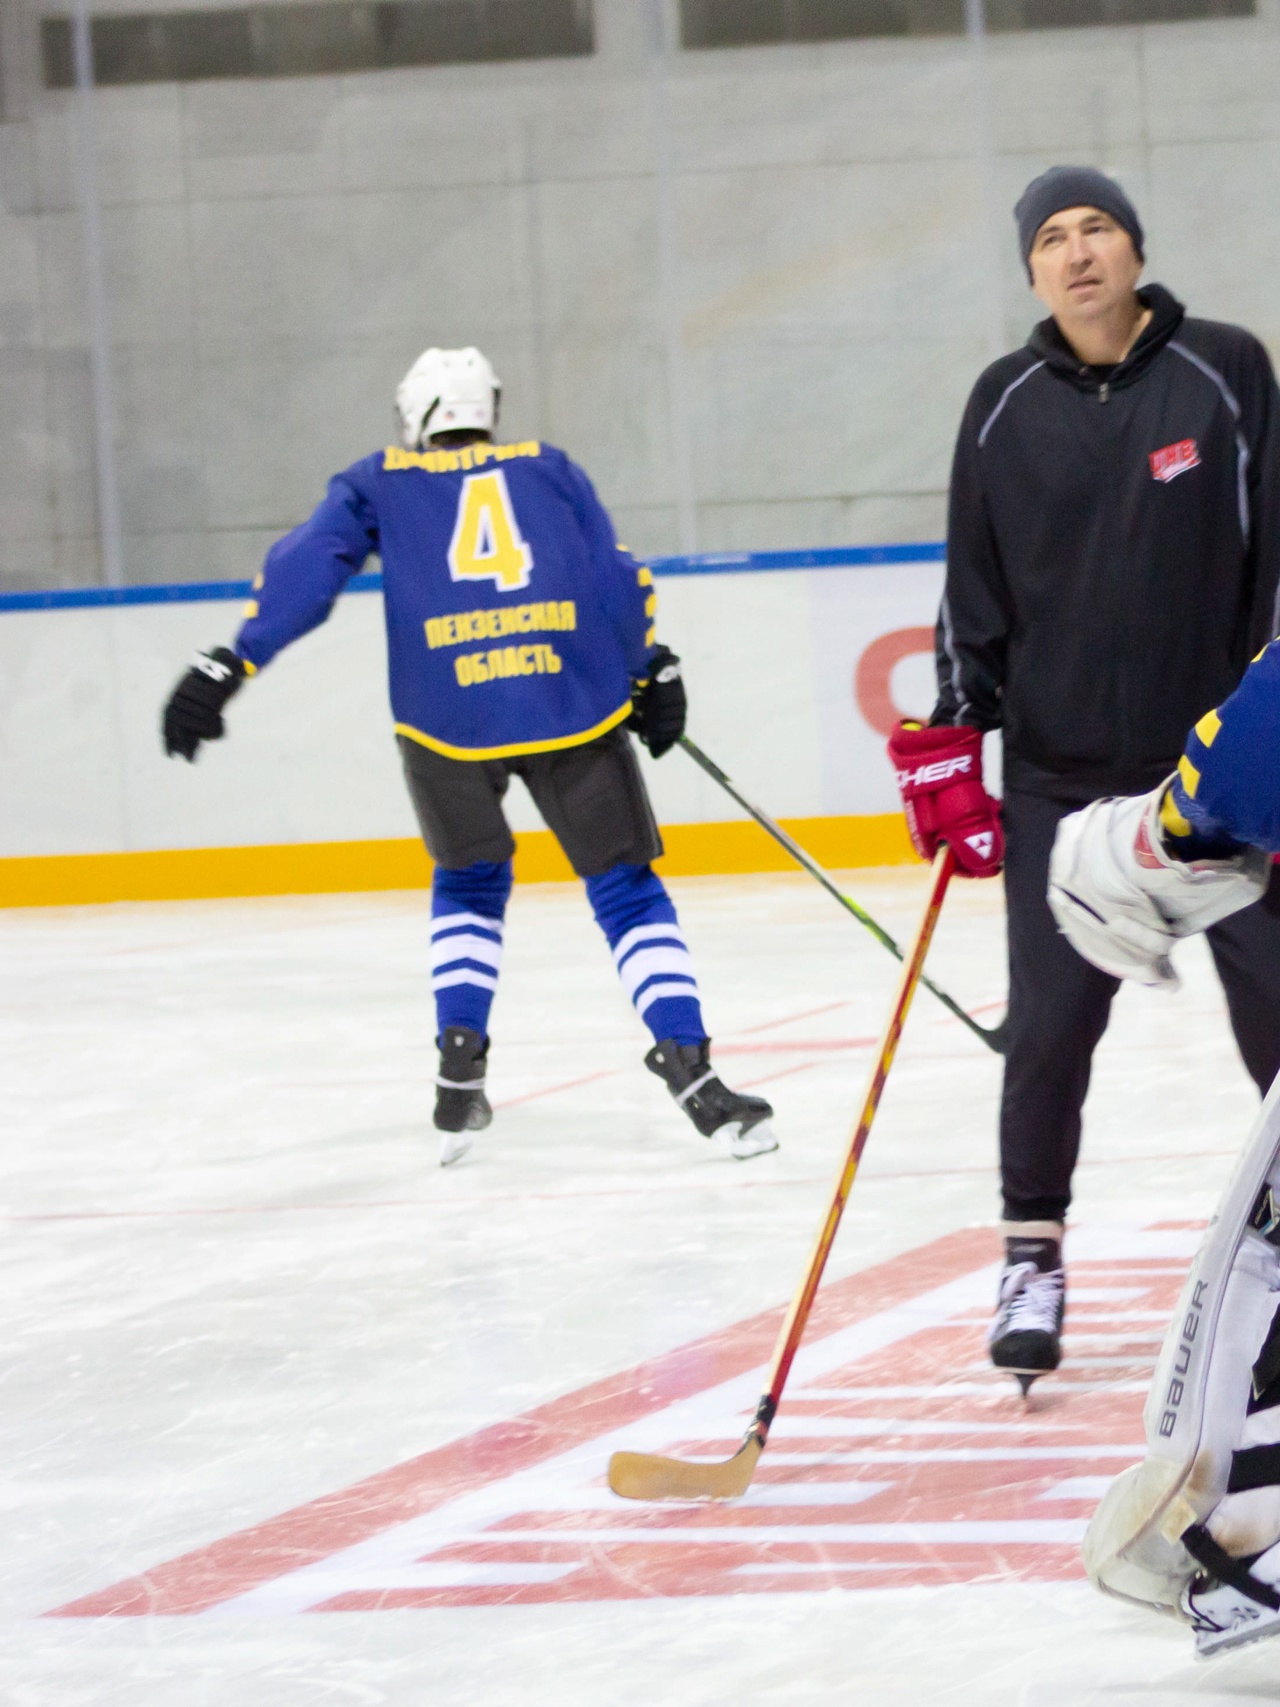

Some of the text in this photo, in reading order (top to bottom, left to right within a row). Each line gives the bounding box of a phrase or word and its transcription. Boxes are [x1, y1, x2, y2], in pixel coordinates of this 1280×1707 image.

[448, 467, 534, 593] 4
[424, 600, 576, 650] ПЕНЗЕНСКАЯ
[454, 643, 562, 687] ОБЛАСТЬ
